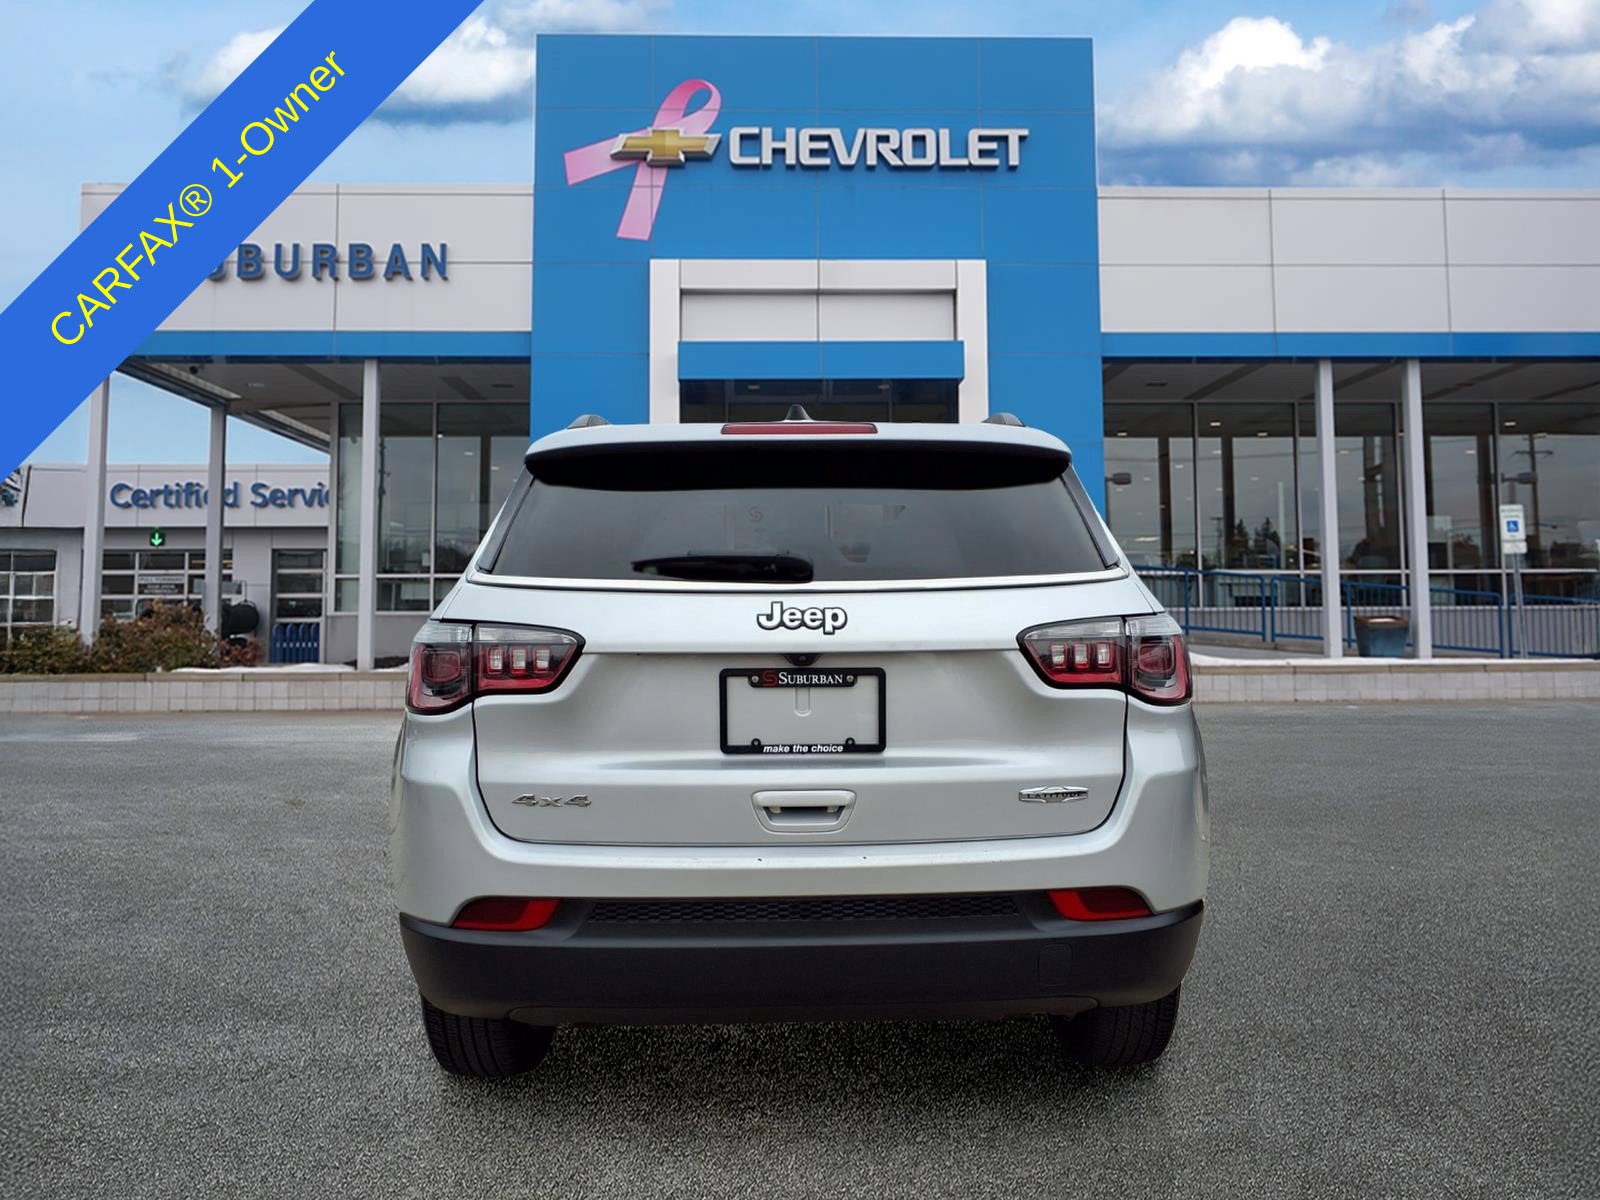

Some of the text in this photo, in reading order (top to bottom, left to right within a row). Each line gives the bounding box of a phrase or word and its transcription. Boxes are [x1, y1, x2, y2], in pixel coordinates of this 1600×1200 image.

[730, 126, 1029, 168] CHEVROLET
[110, 482, 240, 509] Certifid
[757, 601, 847, 635] Jeep
[763, 743, 844, 753] make the choice
